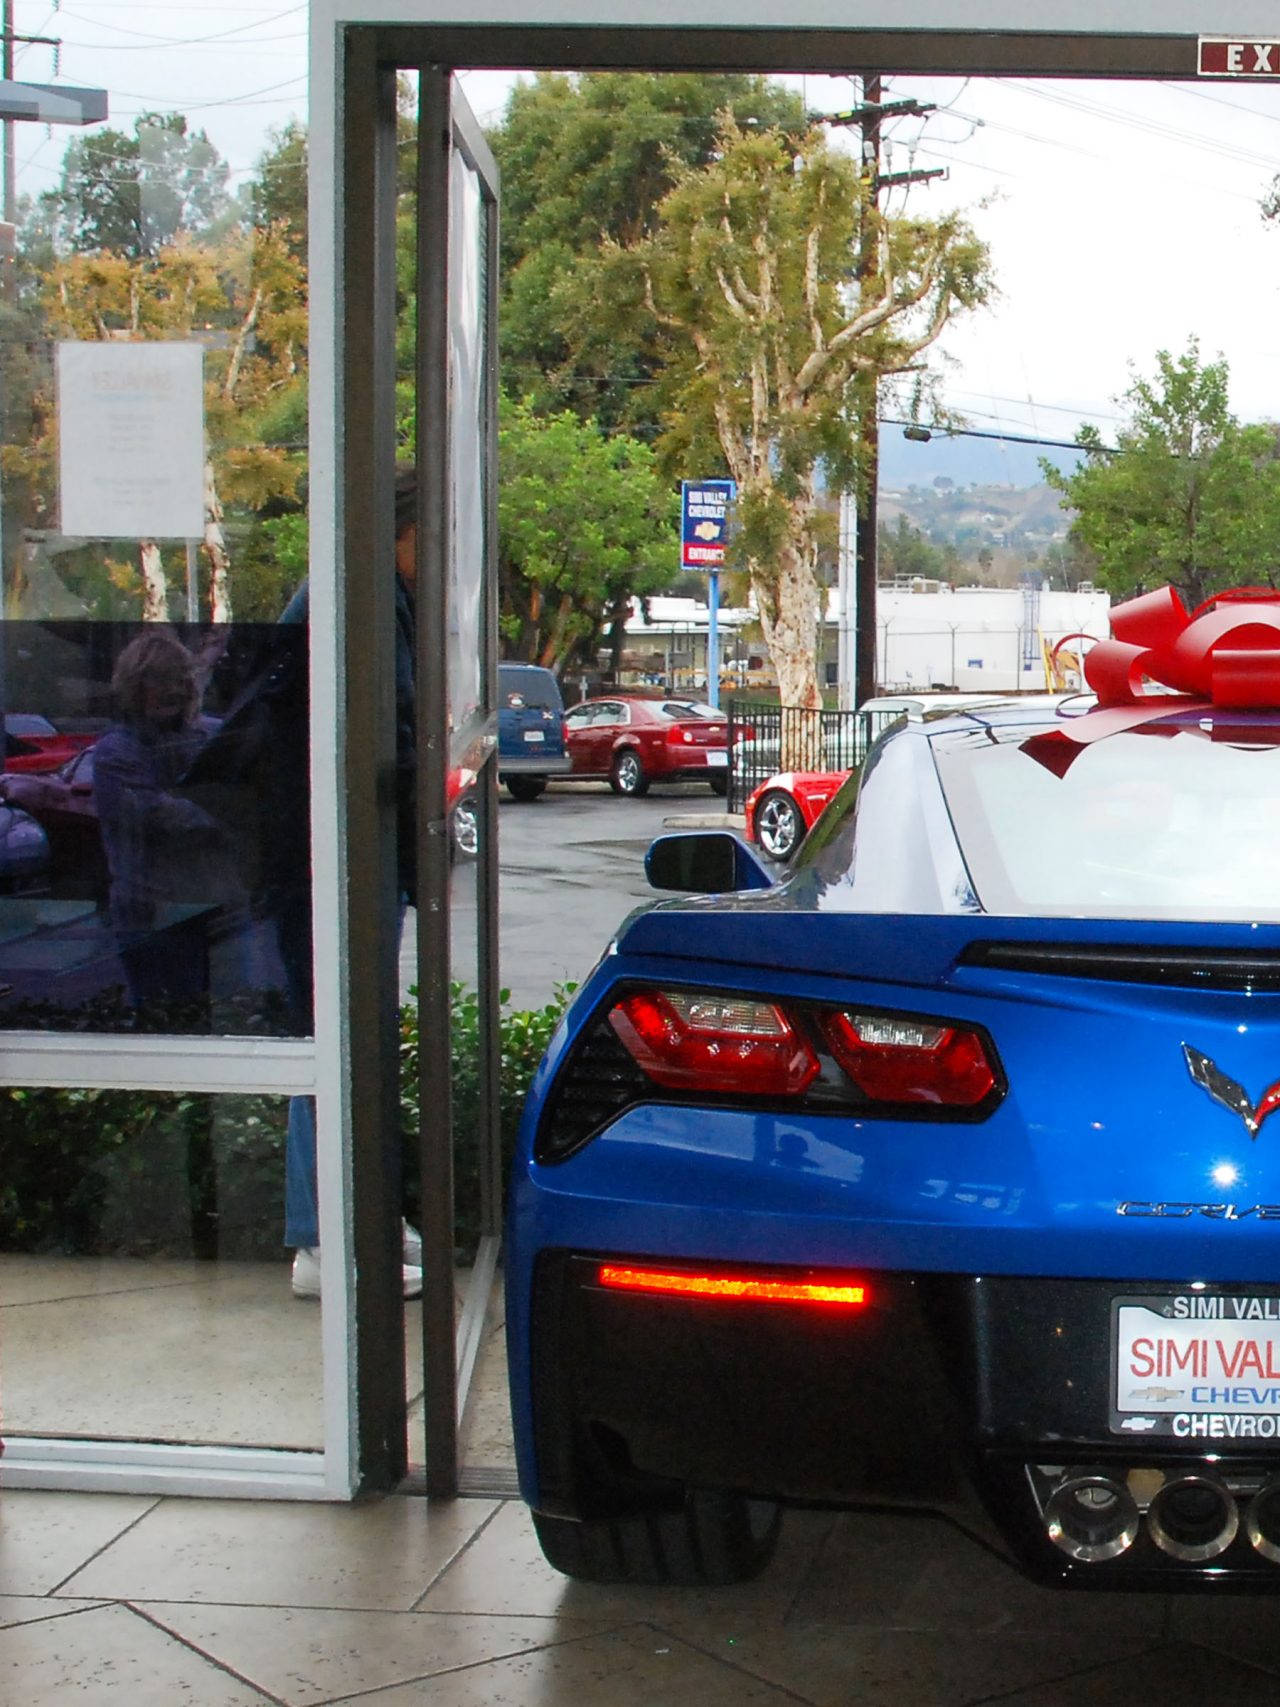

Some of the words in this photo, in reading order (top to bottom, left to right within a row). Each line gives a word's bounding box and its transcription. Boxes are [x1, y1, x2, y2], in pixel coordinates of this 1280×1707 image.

[688, 505, 726, 518] CHEVROLET
[1173, 1296, 1225, 1320] SIMI
[1130, 1338, 1208, 1379] SIMI
